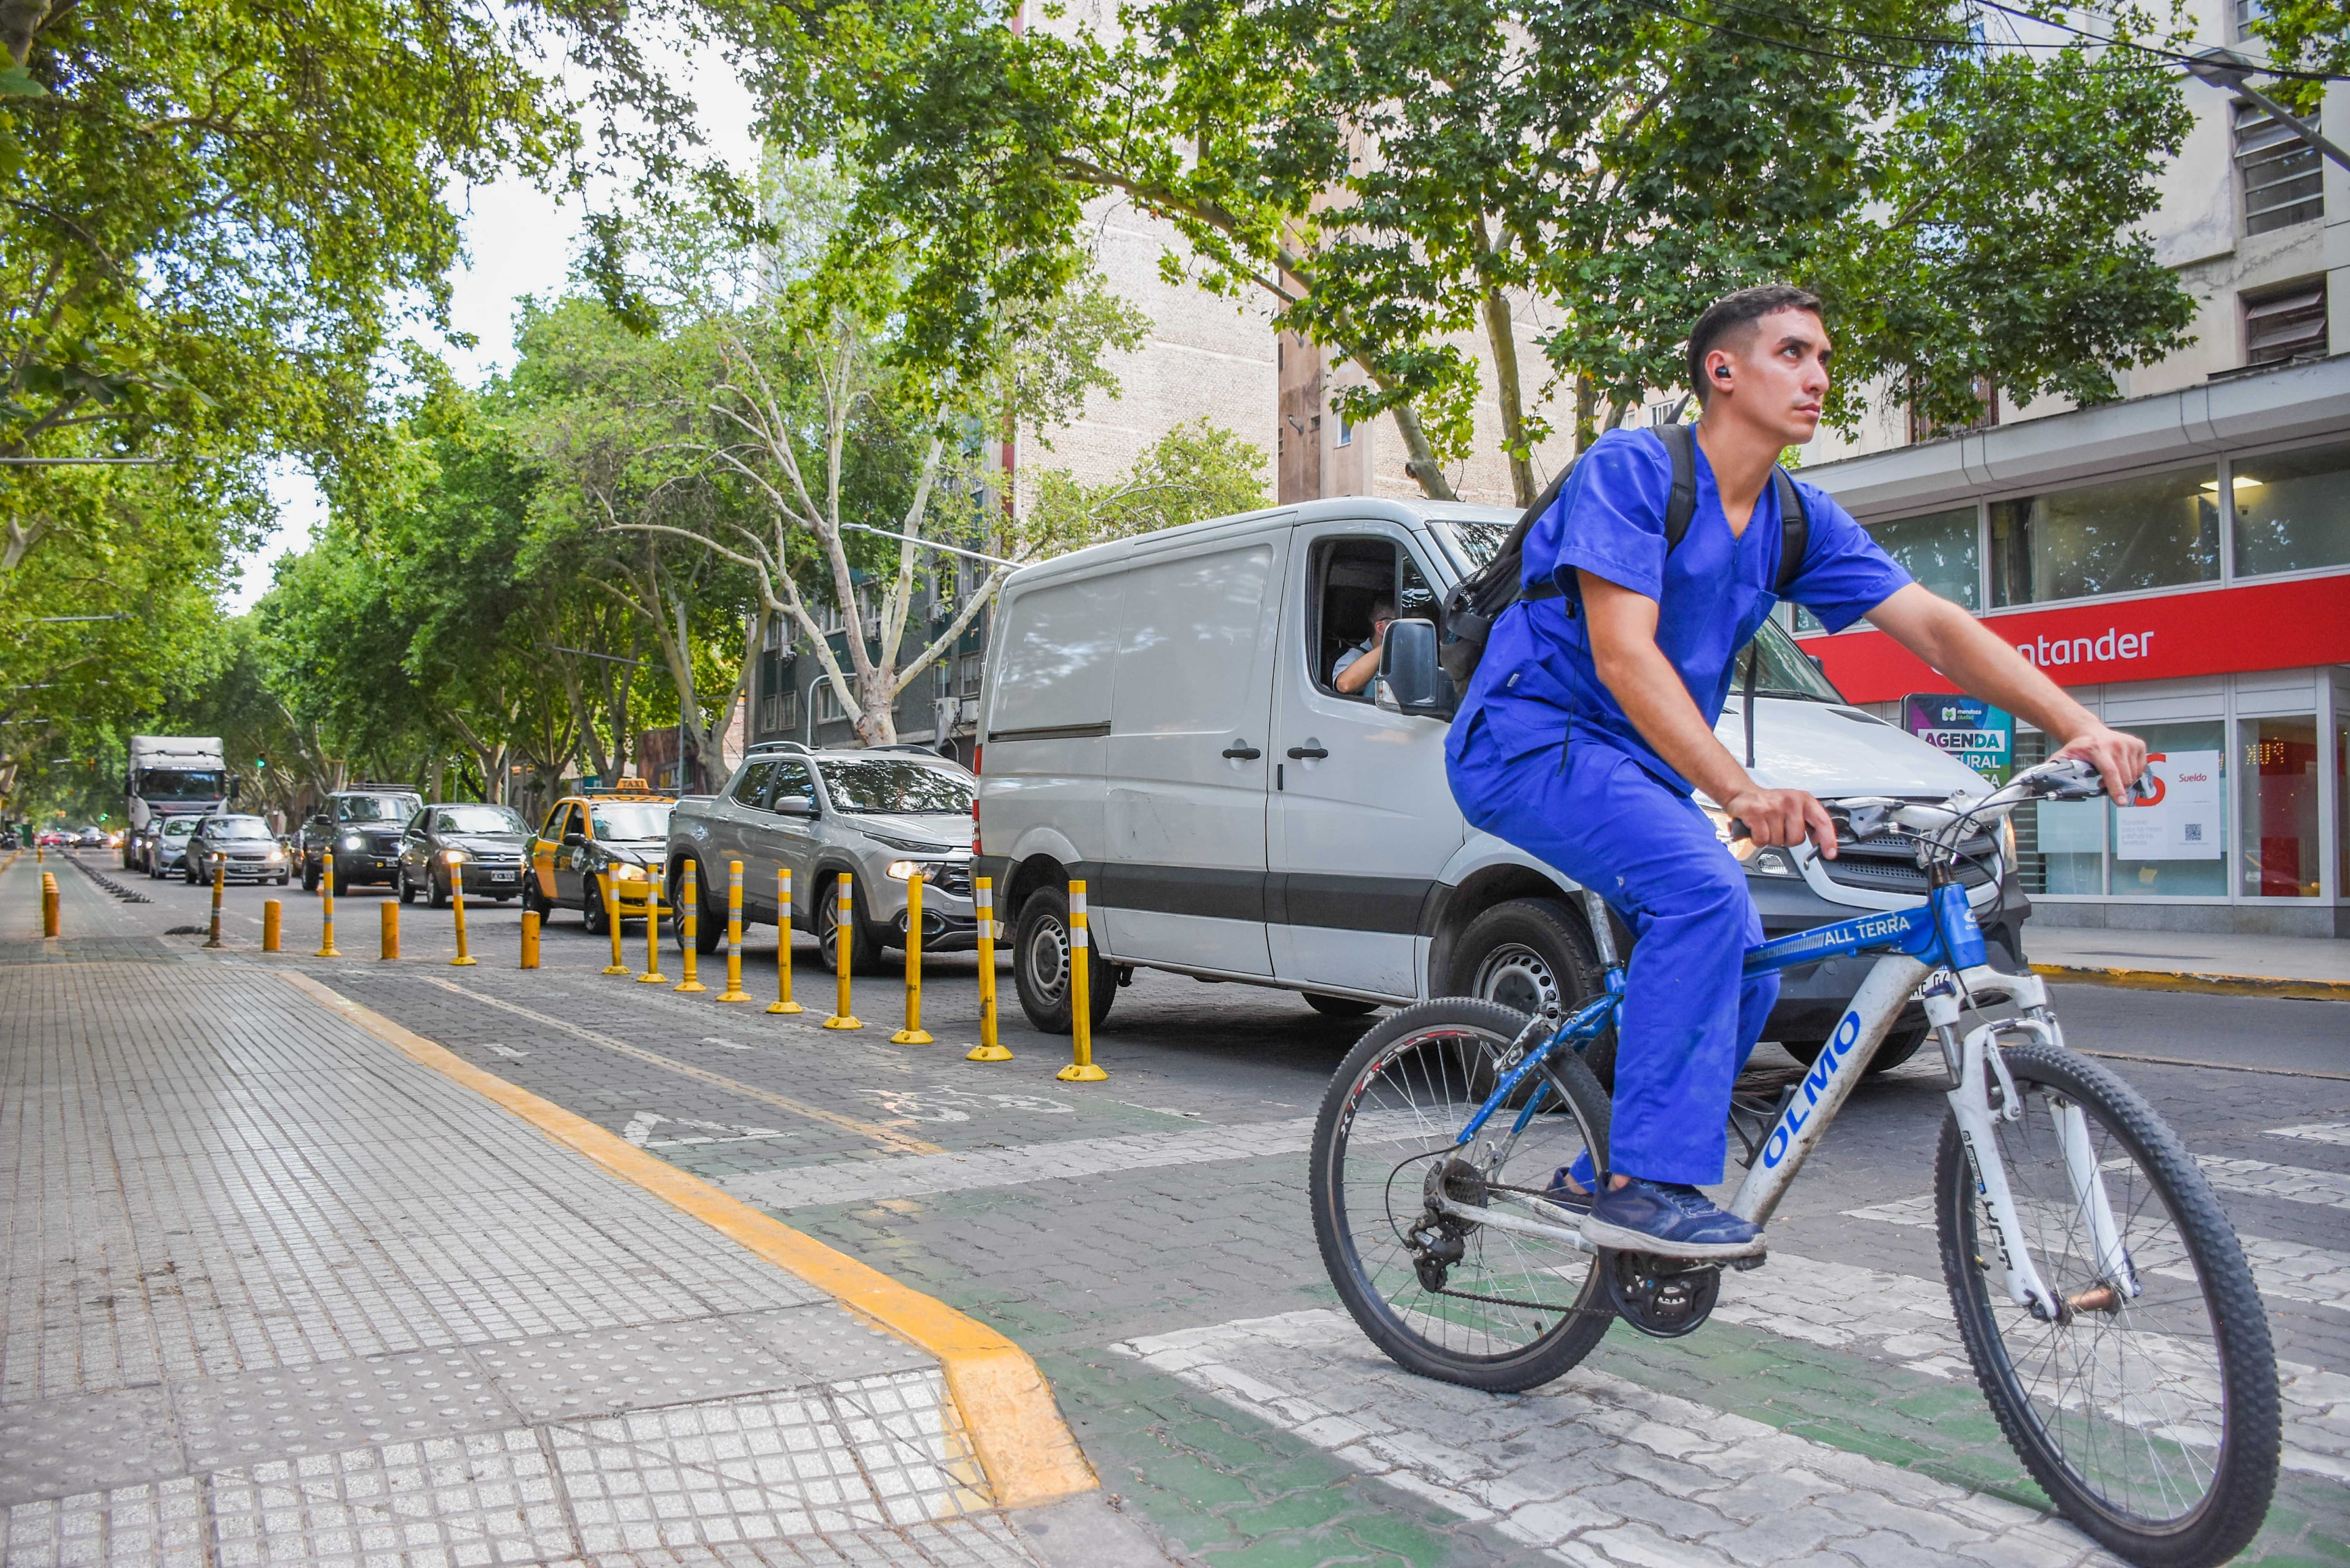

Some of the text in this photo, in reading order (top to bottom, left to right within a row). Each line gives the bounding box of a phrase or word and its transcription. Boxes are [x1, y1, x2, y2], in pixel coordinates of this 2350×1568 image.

[1925, 732, 2000, 749] AGENDA
[2178, 773, 2207, 782] Sueldo
[1825, 916, 1911, 946] ALL TERRA
[1763, 1010, 1861, 1169] OLMO
